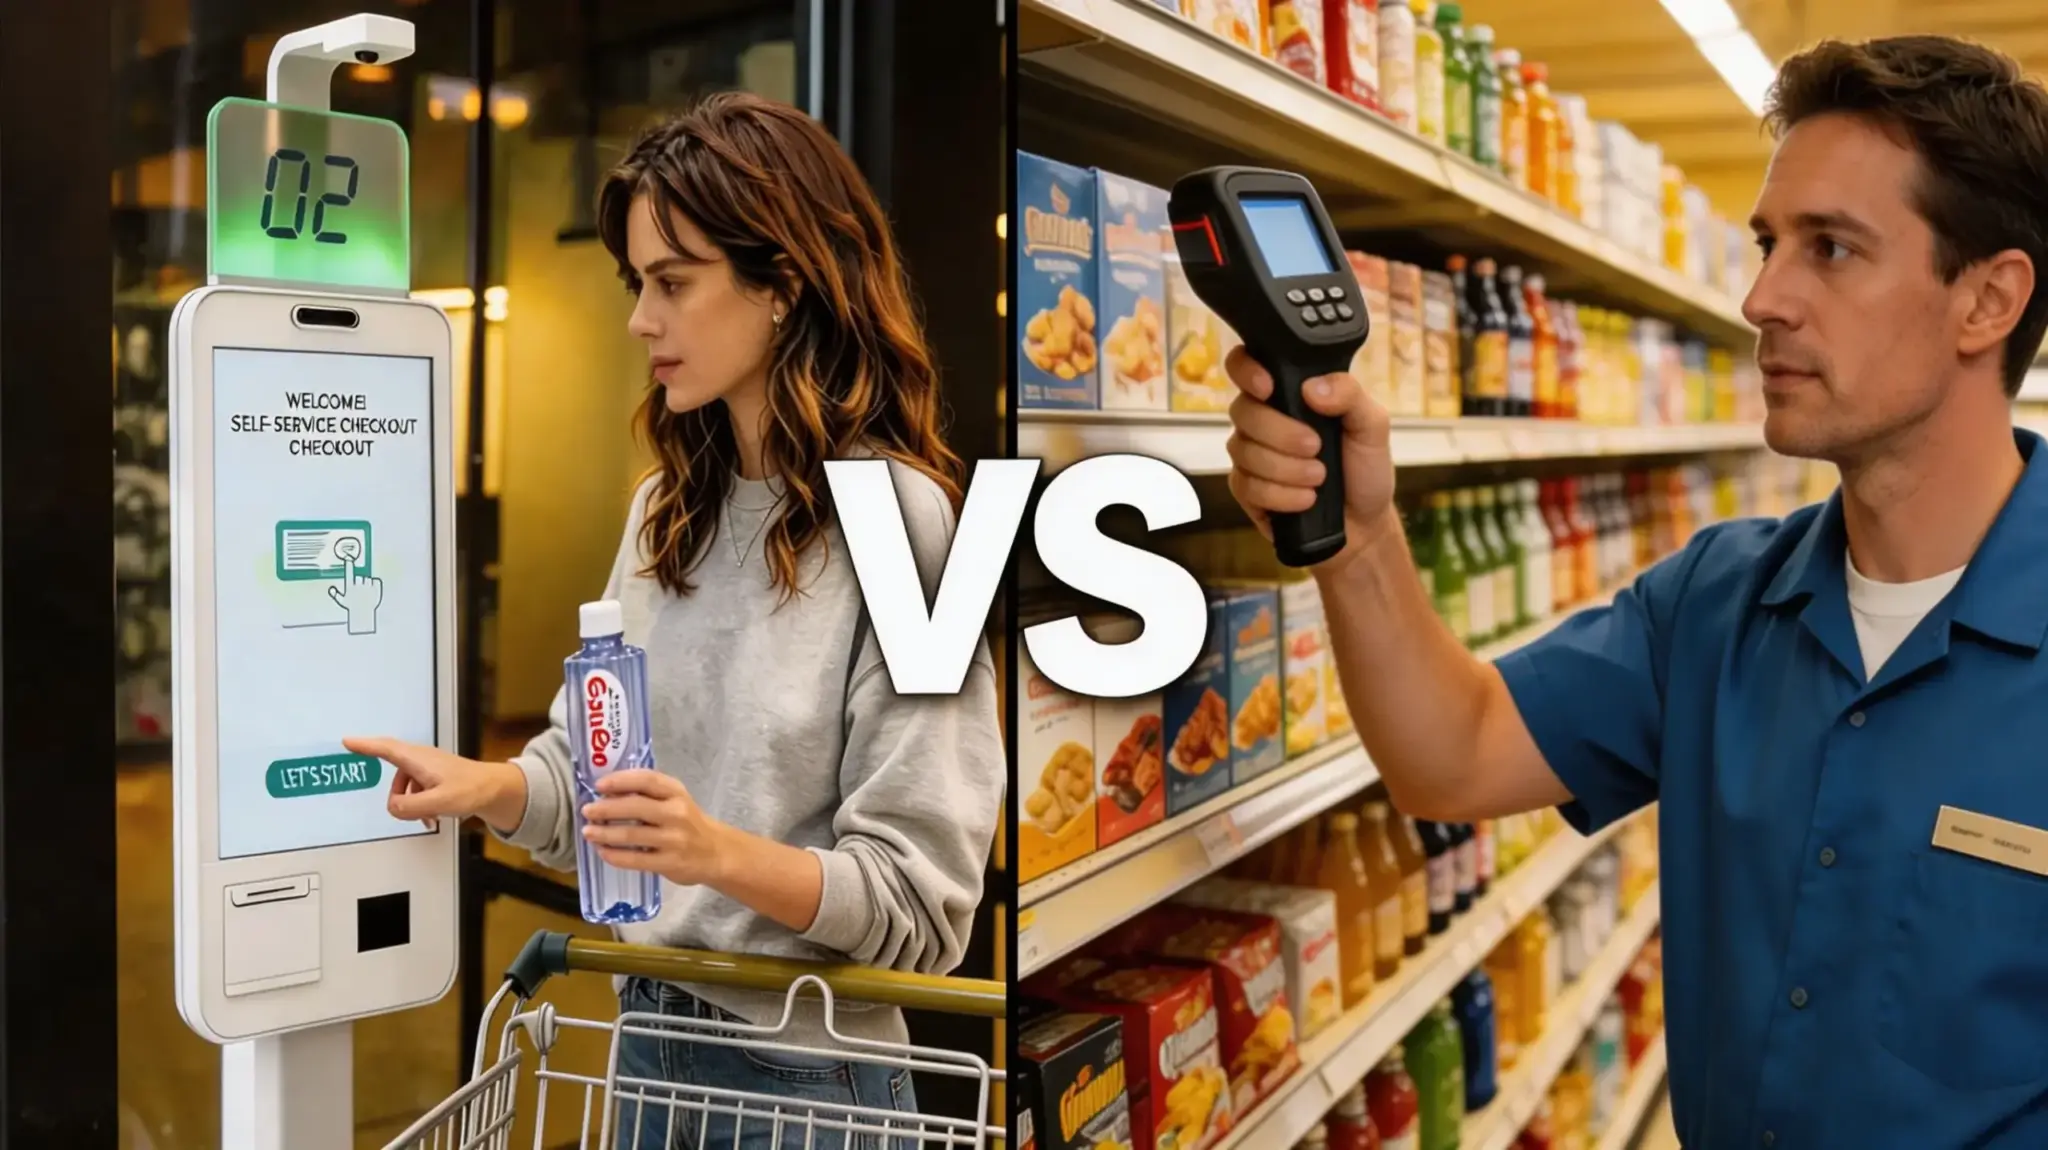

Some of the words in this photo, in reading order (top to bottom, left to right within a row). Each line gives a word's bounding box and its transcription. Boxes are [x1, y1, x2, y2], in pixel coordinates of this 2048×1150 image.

[260, 148, 359, 244] 02
[340, 417, 417, 434] CHECKOUT
[280, 767, 321, 789] LET'S
[321, 761, 367, 786] START
